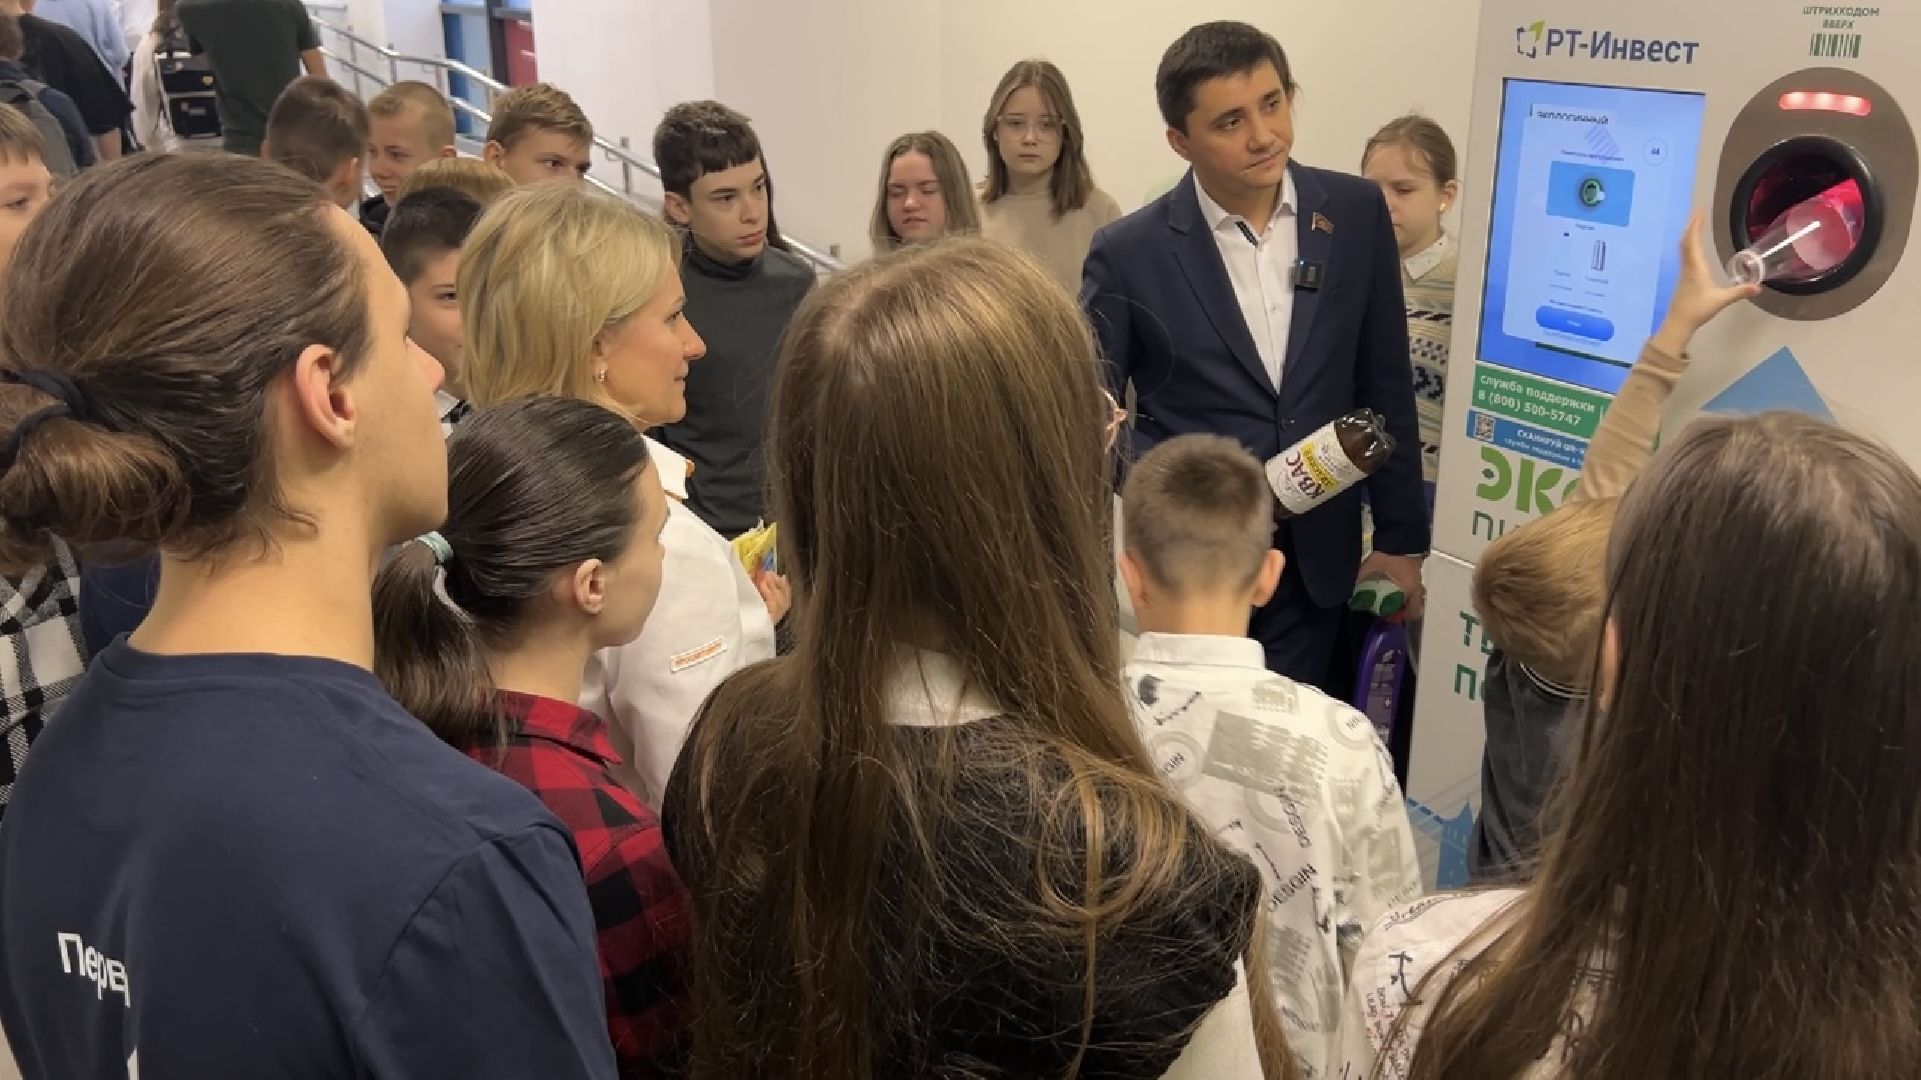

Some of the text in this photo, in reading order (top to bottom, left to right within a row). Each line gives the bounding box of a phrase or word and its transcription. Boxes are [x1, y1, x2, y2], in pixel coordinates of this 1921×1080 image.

[1803, 6, 1880, 17] ШТРИХКОДОМ
[1823, 19, 1854, 28] ВВЕРХ
[1545, 28, 1699, 64] РТ-Инвест
[1478, 390, 1581, 426] 8 (800) 500-5747
[1480, 375, 1595, 412] служба поддержки
[1517, 429, 1562, 448] СКАНИРУЙ
[1285, 450, 1325, 499] КВАС
